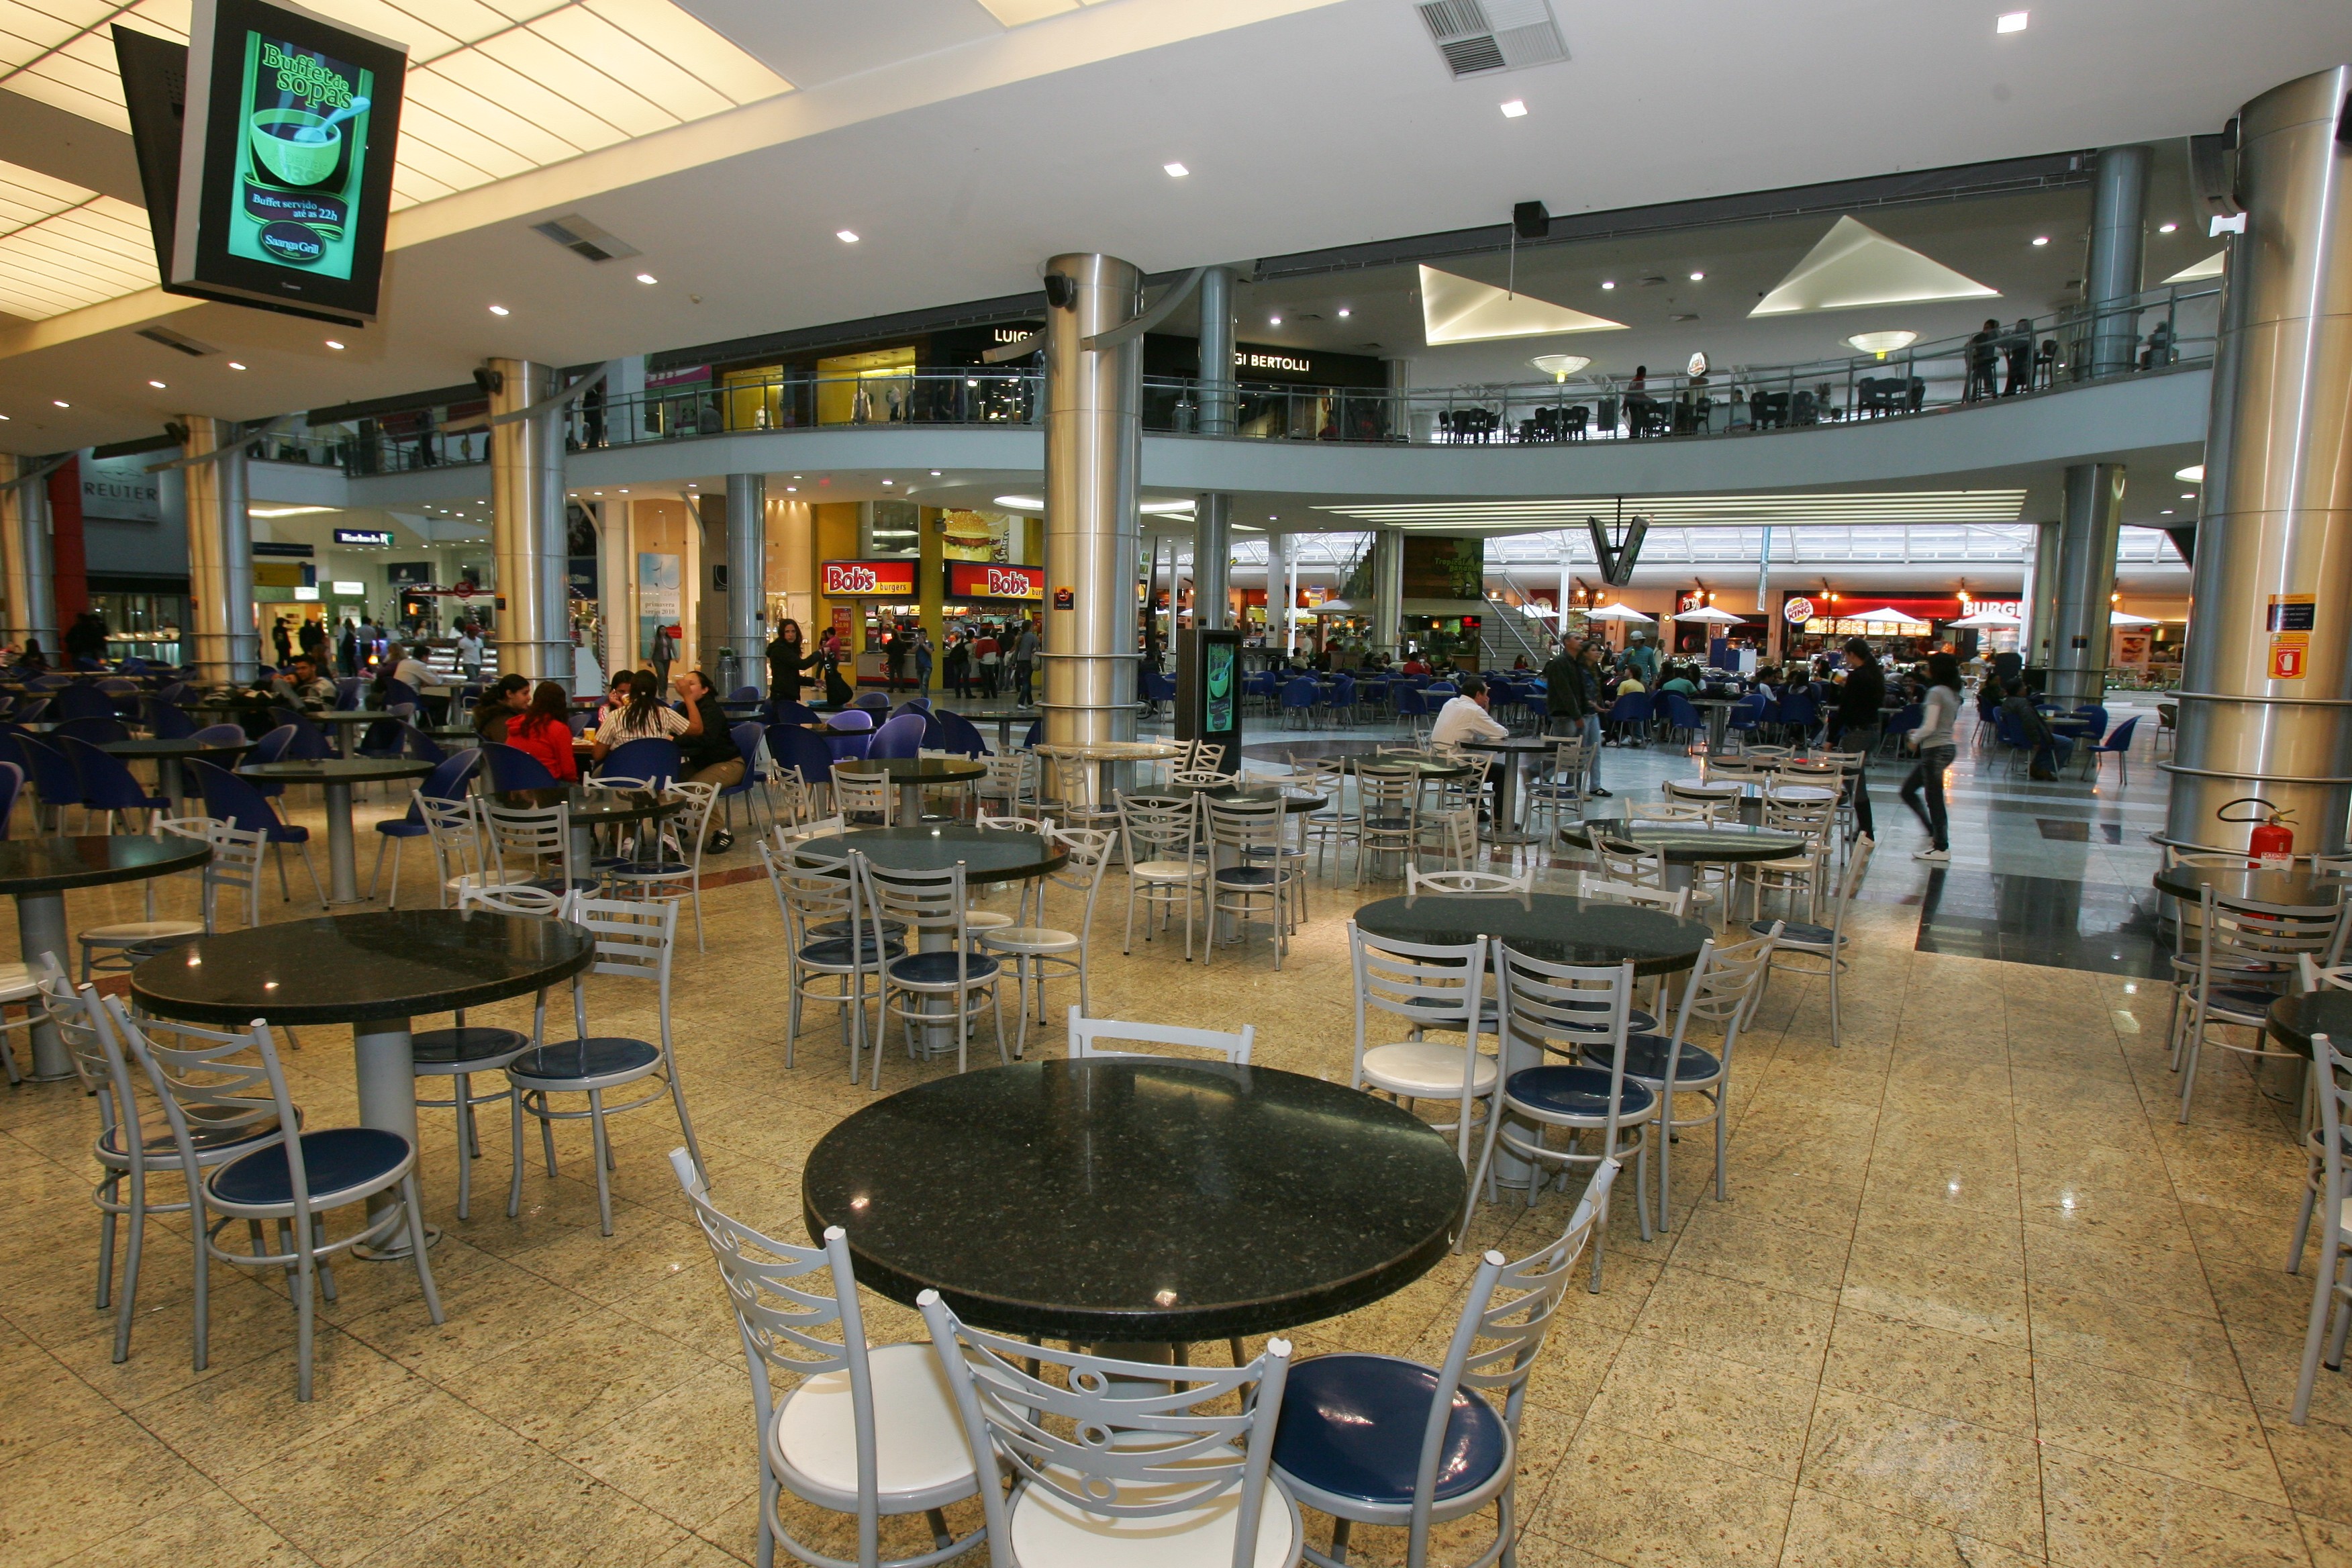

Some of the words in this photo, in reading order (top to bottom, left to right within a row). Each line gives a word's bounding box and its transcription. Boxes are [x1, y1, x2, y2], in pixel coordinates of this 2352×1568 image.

[262, 43, 333, 85] Buffet
[332, 74, 349, 91] de
[277, 70, 353, 111] sopas
[252, 193, 281, 208] Buffet
[282, 199, 317, 210] servido
[293, 209, 307, 218] até
[318, 208, 338, 222] 22h
[299, 242, 320, 254] Grill
[1251, 354, 1310, 372] BERTOLLI
[83, 482, 158, 501] REUTER
[1434, 558, 1465, 567] Tropical
[828, 567, 877, 593] Bob's
[880, 583, 907, 593] burgers
[988, 569, 1029, 597] Bob's
[1787, 601, 1810, 614] BURGER
[1788, 607, 1810, 620] KING
